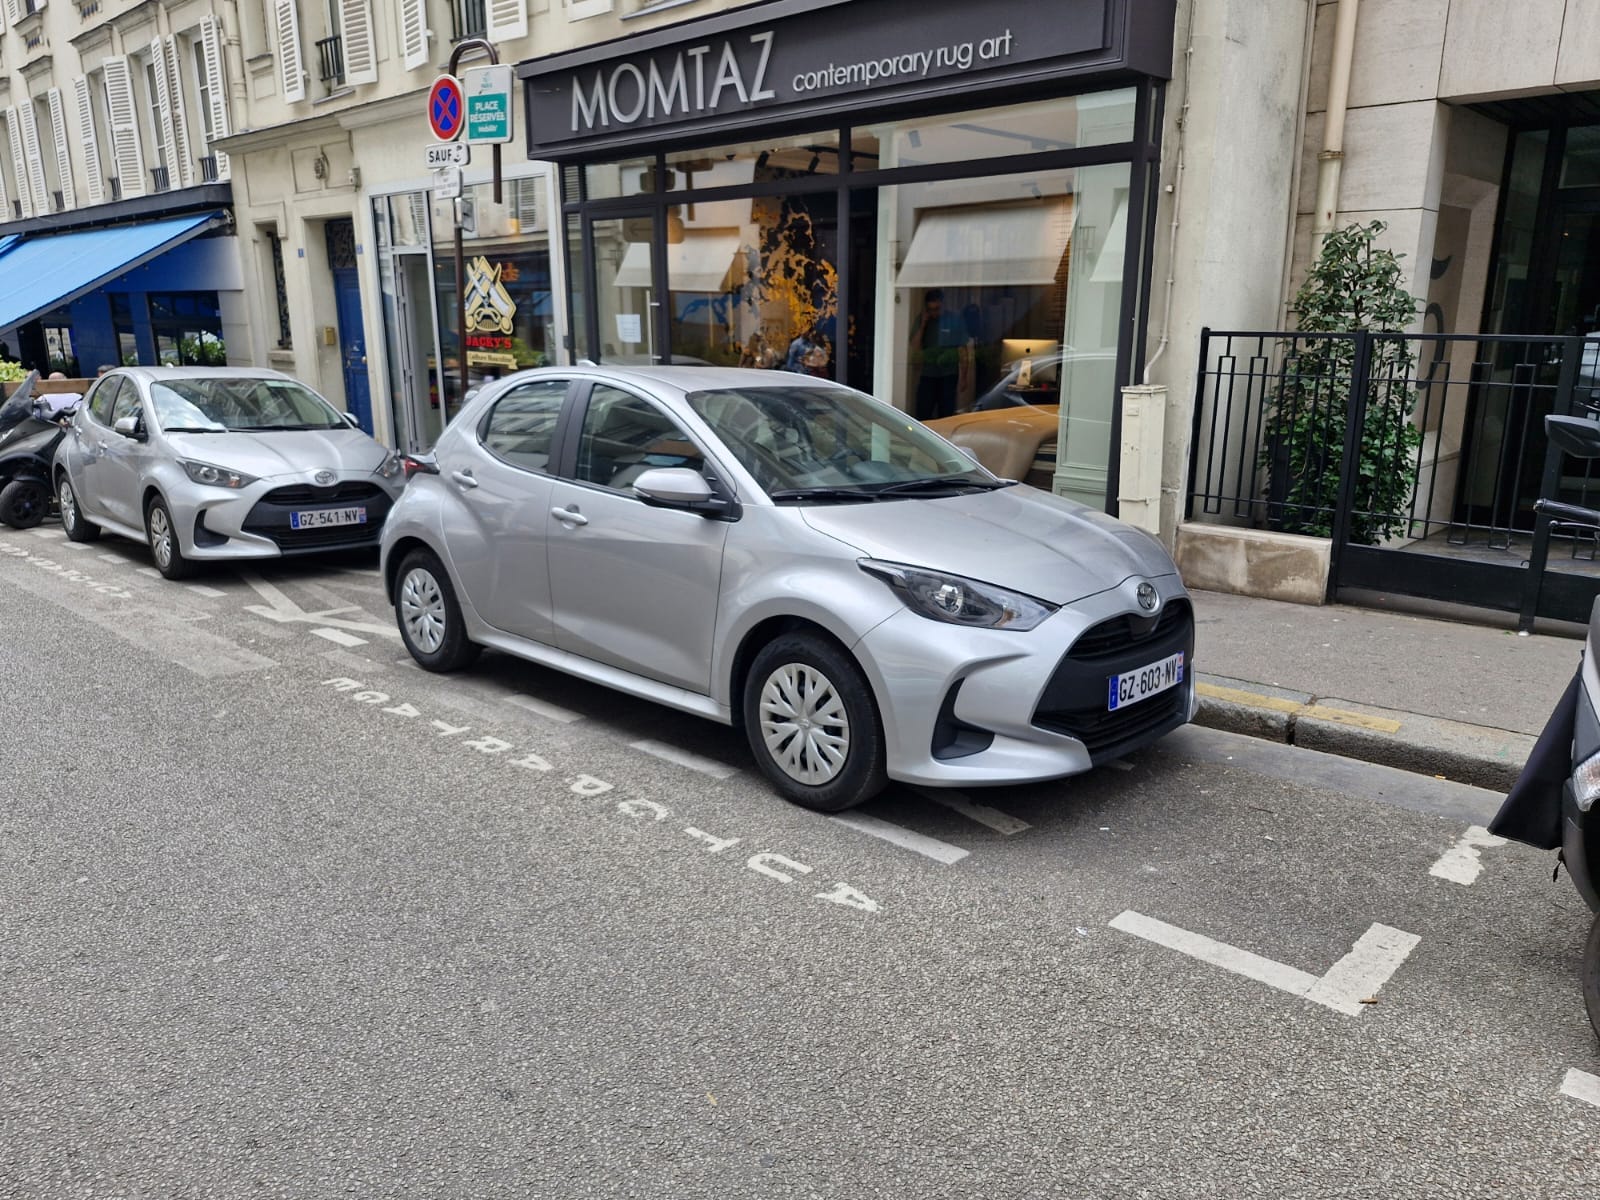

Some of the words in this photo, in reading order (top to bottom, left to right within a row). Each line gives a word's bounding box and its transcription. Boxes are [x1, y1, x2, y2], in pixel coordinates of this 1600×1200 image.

[792, 50, 933, 92] contemporary
[937, 42, 973, 69] rug
[979, 29, 1012, 59] art
[571, 31, 775, 131] MOMTAZ
[475, 101, 499, 111] PLACE
[429, 149, 452, 163] SAUF
[465, 335, 512, 349] JACKY'S
